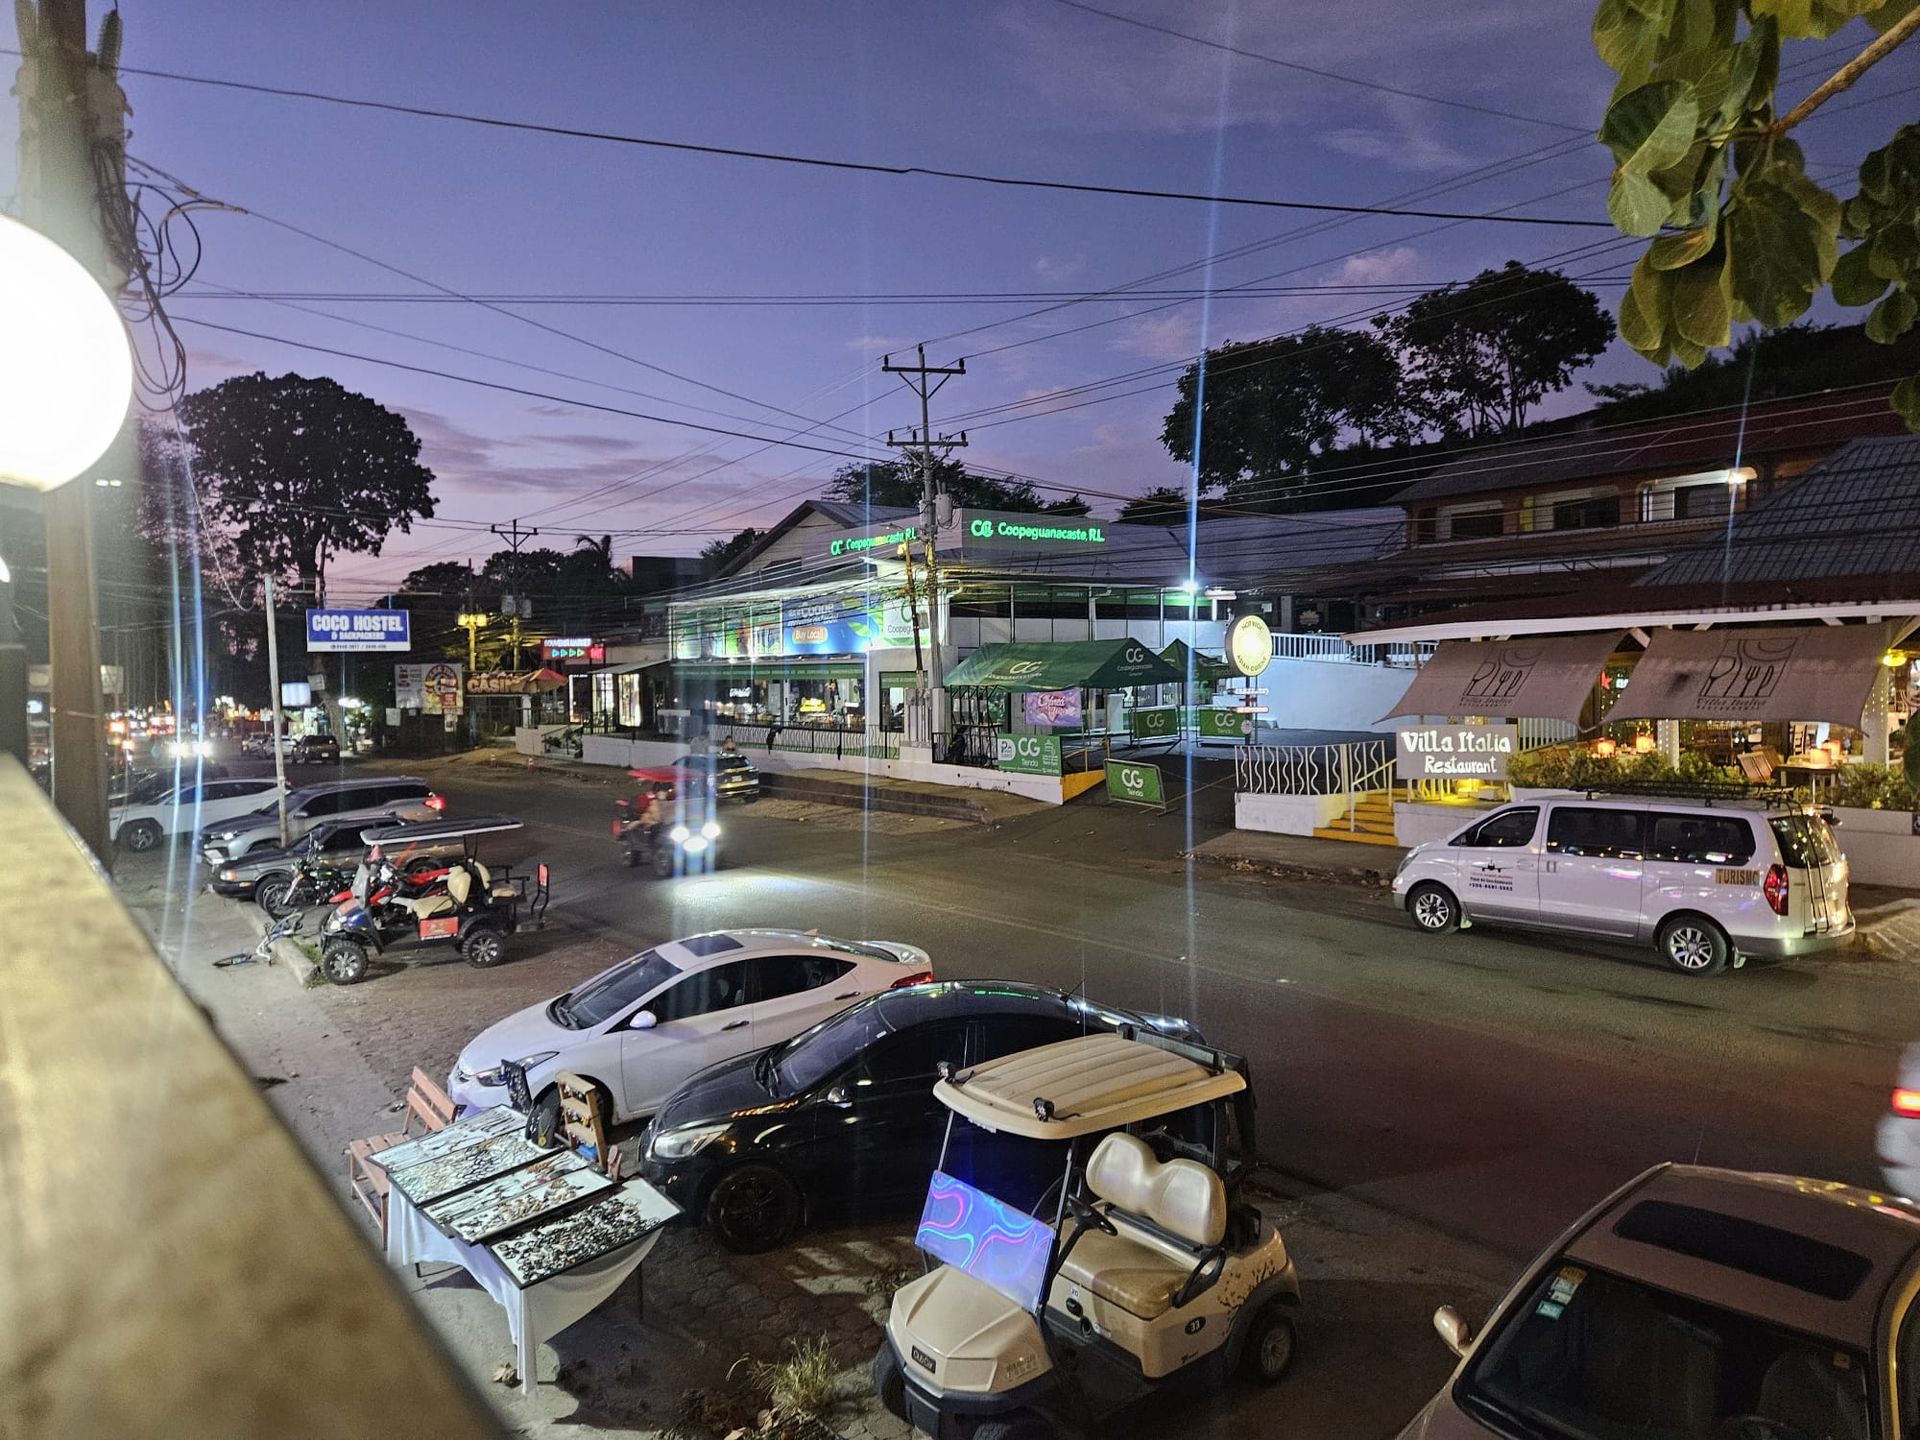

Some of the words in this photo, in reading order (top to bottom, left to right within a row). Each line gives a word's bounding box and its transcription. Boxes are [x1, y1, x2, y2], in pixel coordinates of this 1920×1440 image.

[312, 615, 350, 632] COCO
[353, 615, 404, 632] HOSTEL
[1125, 648, 1145, 663] CG
[1146, 713, 1165, 728] CG
[1215, 713, 1235, 727] CG
[1018, 737, 1040, 757] CG
[1401, 730, 1453, 753] Villa
[1457, 731, 1511, 753] Italia
[1424, 756, 1497, 774] Restaurant
[1121, 769, 1144, 789] CG
[1717, 869, 1759, 885] TURISMO
[1190, 1320, 1200, 1332] 33
